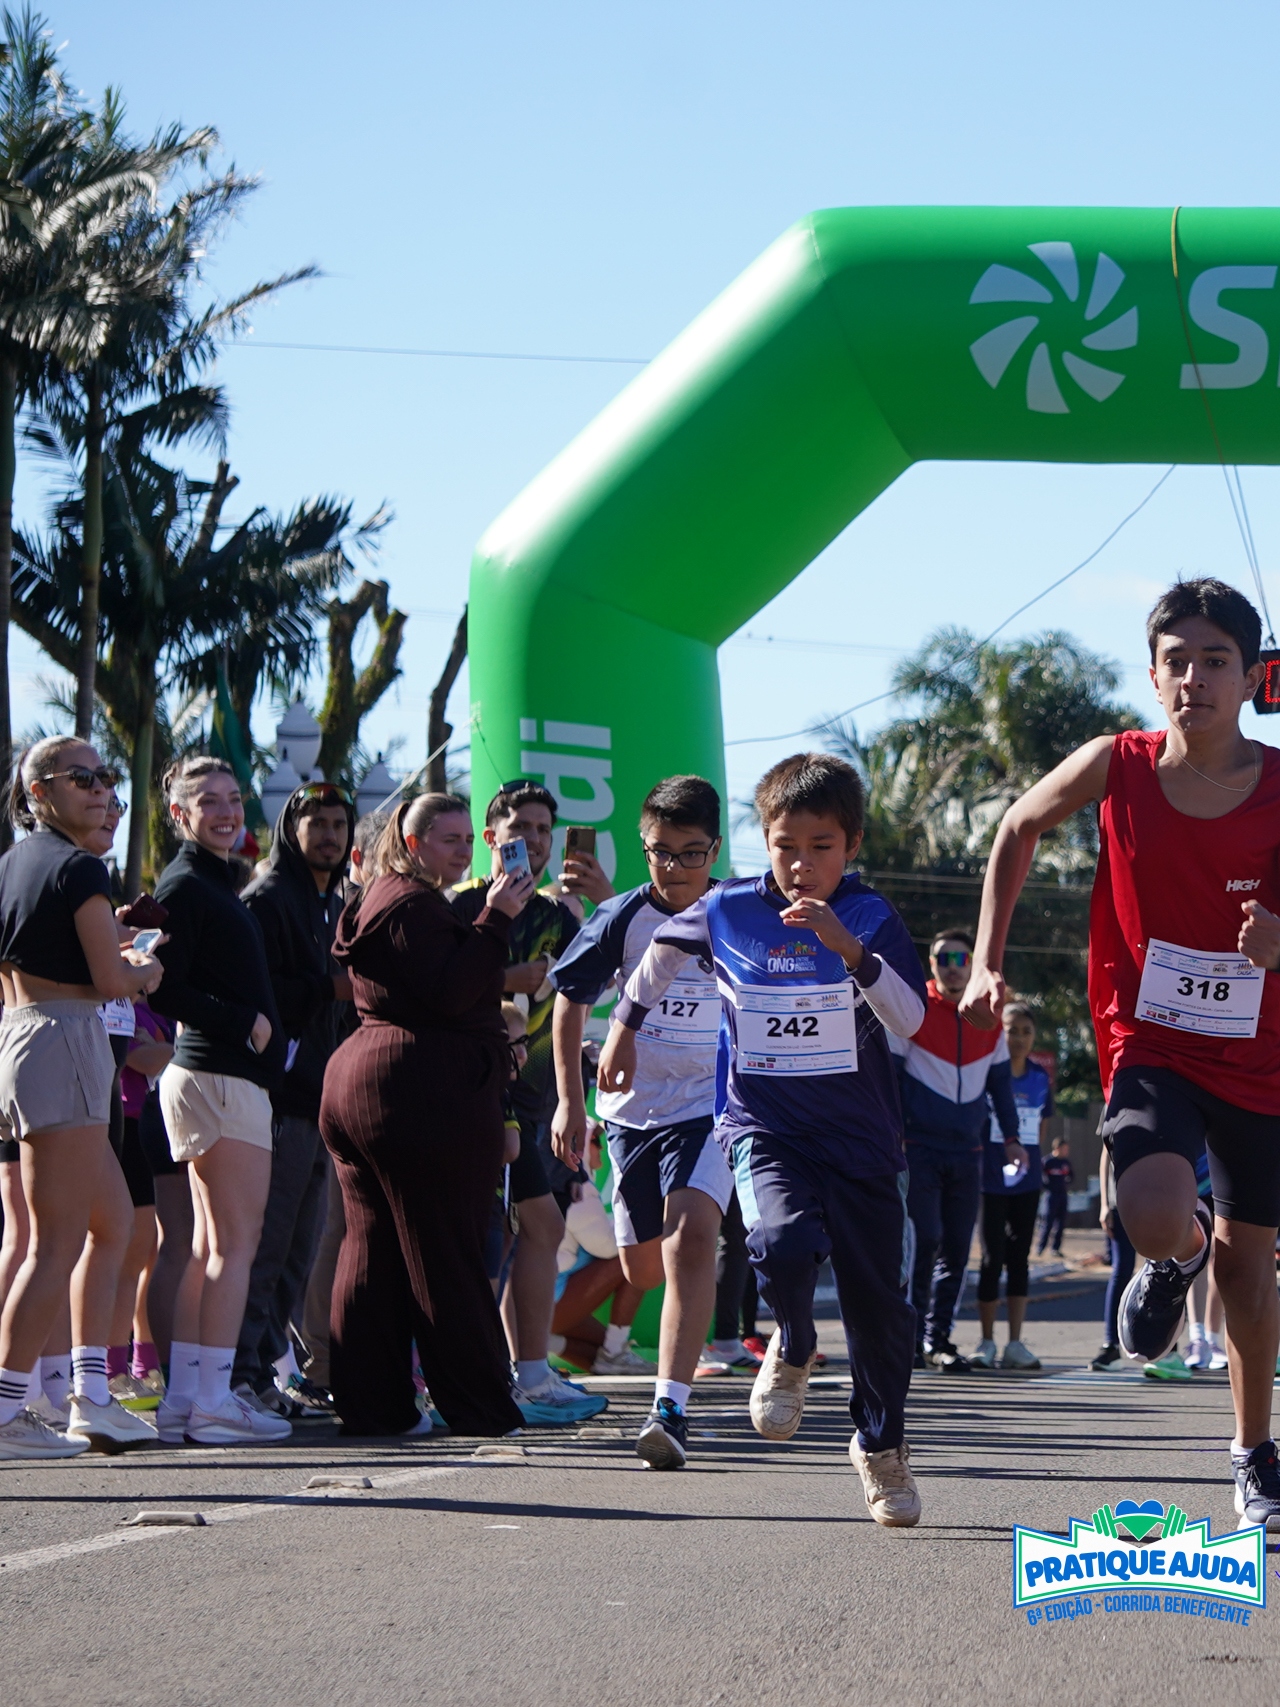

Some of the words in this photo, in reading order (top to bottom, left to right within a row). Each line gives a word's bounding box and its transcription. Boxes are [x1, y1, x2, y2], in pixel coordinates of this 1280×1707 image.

[1225, 879, 1261, 892] HIGH
[768, 957, 795, 973] ONG
[1177, 976, 1230, 1002] 318
[659, 999, 699, 1018] 127
[766, 1016, 819, 1038] 242
